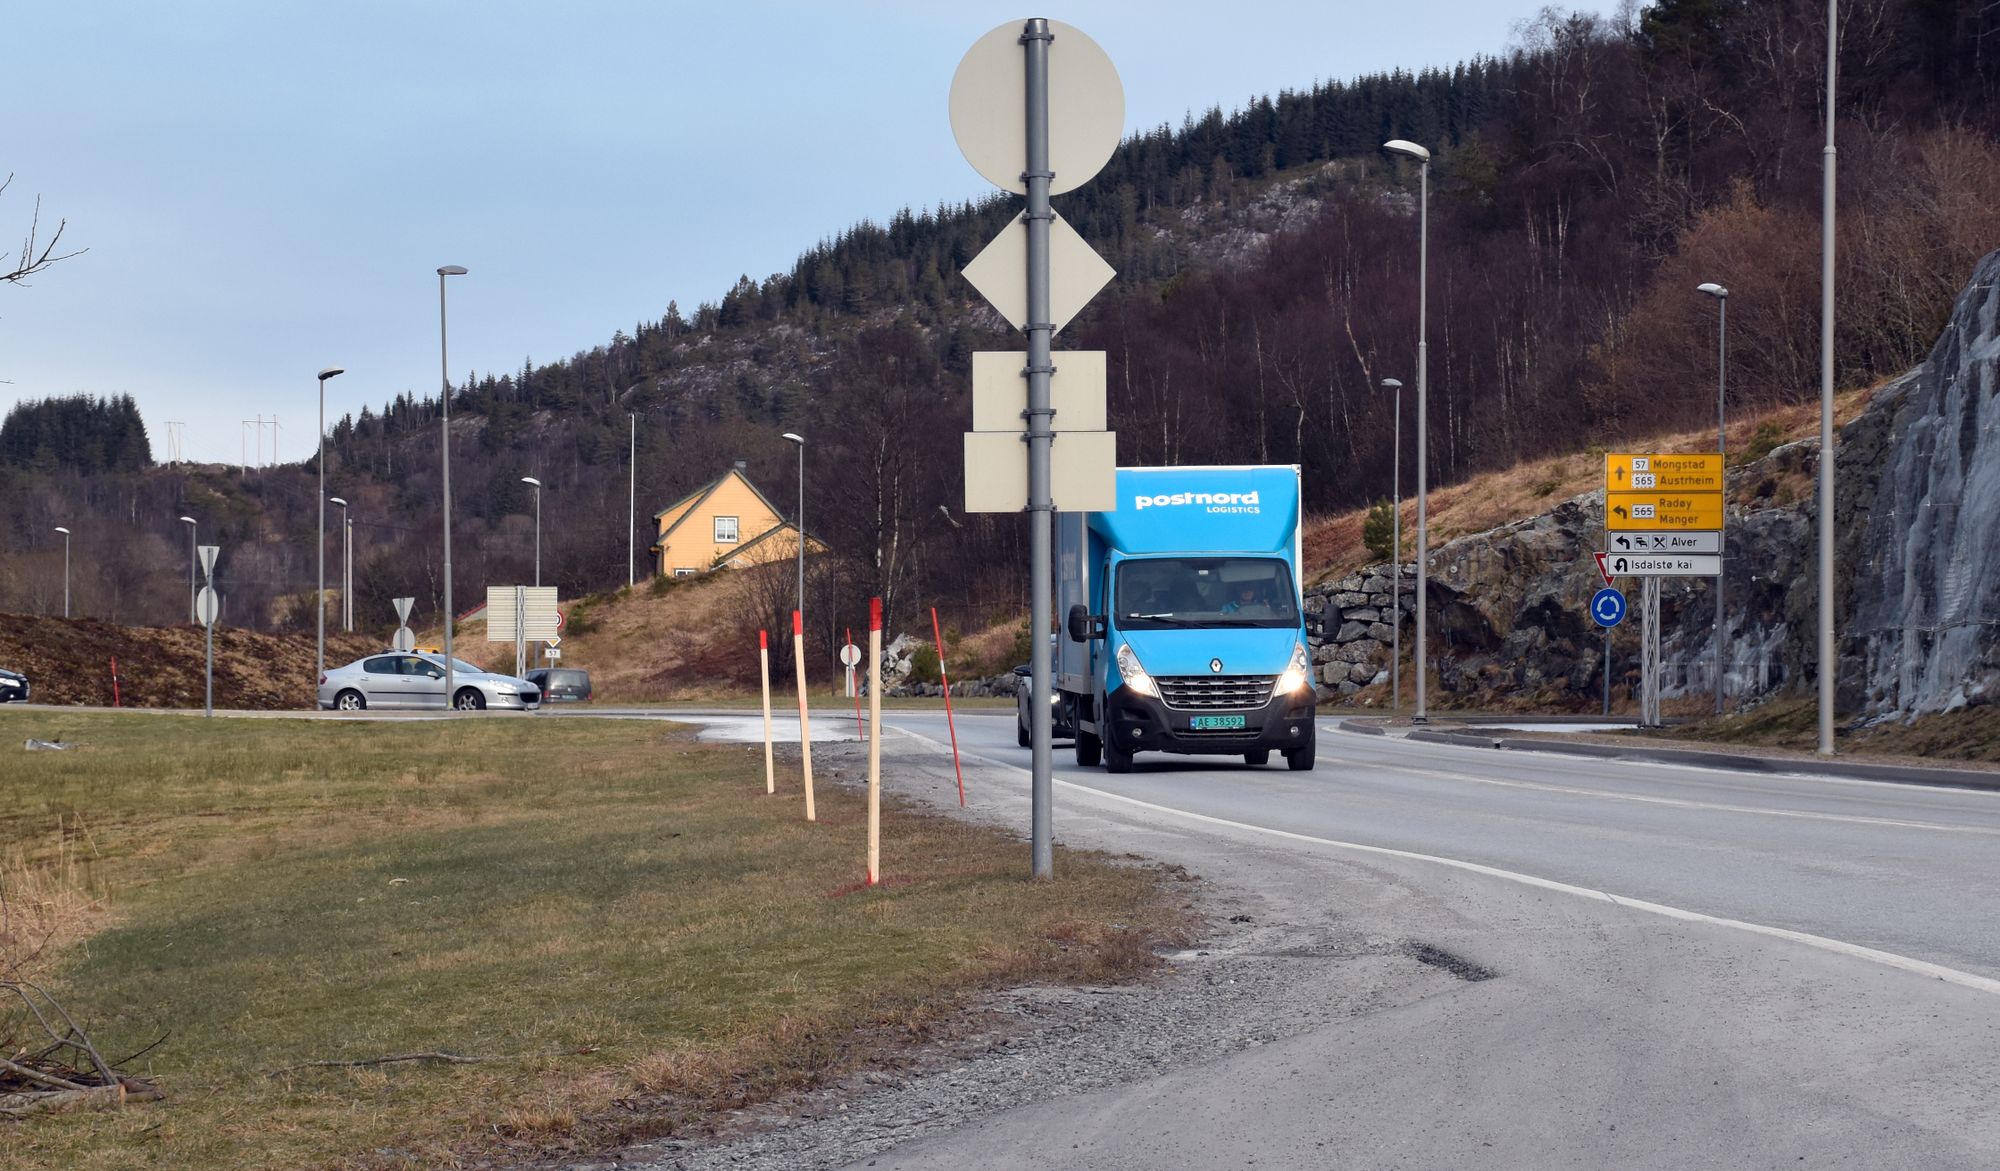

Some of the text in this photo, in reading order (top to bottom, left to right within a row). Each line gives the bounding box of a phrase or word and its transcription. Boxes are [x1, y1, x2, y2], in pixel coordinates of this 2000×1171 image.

[1635, 460, 1705, 471] 57 Mongstad
[1635, 476, 1714, 485] 565 Austrheim
[1135, 491, 1260, 510] postnord
[1659, 499, 1692, 509] Radøy
[1206, 506, 1261, 514] LOGISTICS
[1634, 508, 1653, 516] 565
[1659, 515, 1698, 525] Manger
[1671, 537, 1697, 547] Alver
[1631, 560, 1692, 569] Isdalstø kai
[1198, 718, 1243, 726] AE 38592
